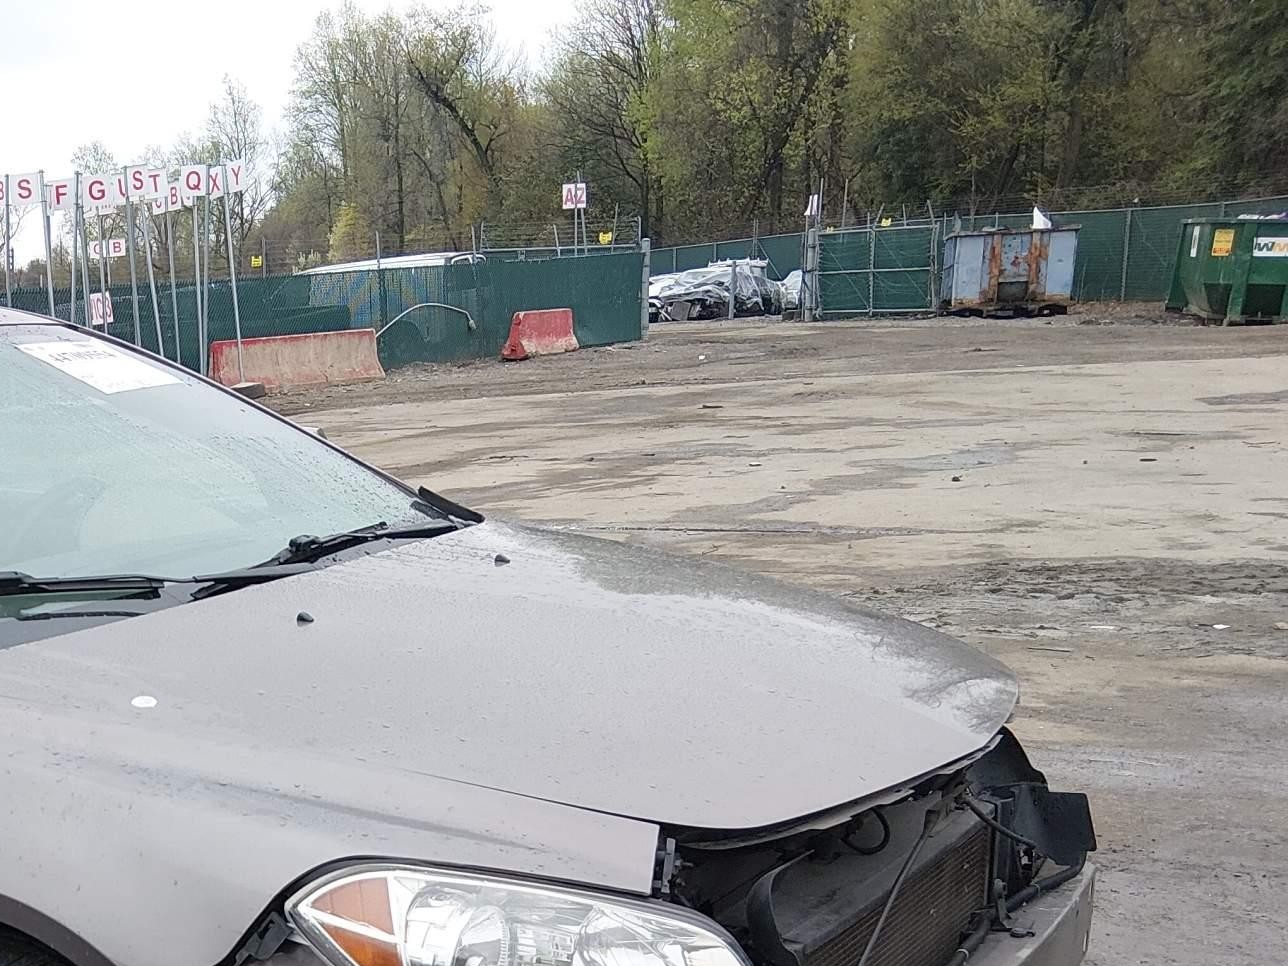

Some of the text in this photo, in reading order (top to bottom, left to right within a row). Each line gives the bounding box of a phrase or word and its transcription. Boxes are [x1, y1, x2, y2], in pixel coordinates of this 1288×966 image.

[17, 179, 32, 200] S
[133, 170, 144, 191] S
[148, 173, 160, 193] T
[186, 170, 201, 191] Q
[209, 165, 241, 193] X Y
[55, 184, 68, 205] F
[88, 180, 106, 201] G
[169, 186, 179, 205] B
[113, 241, 122, 254] B
